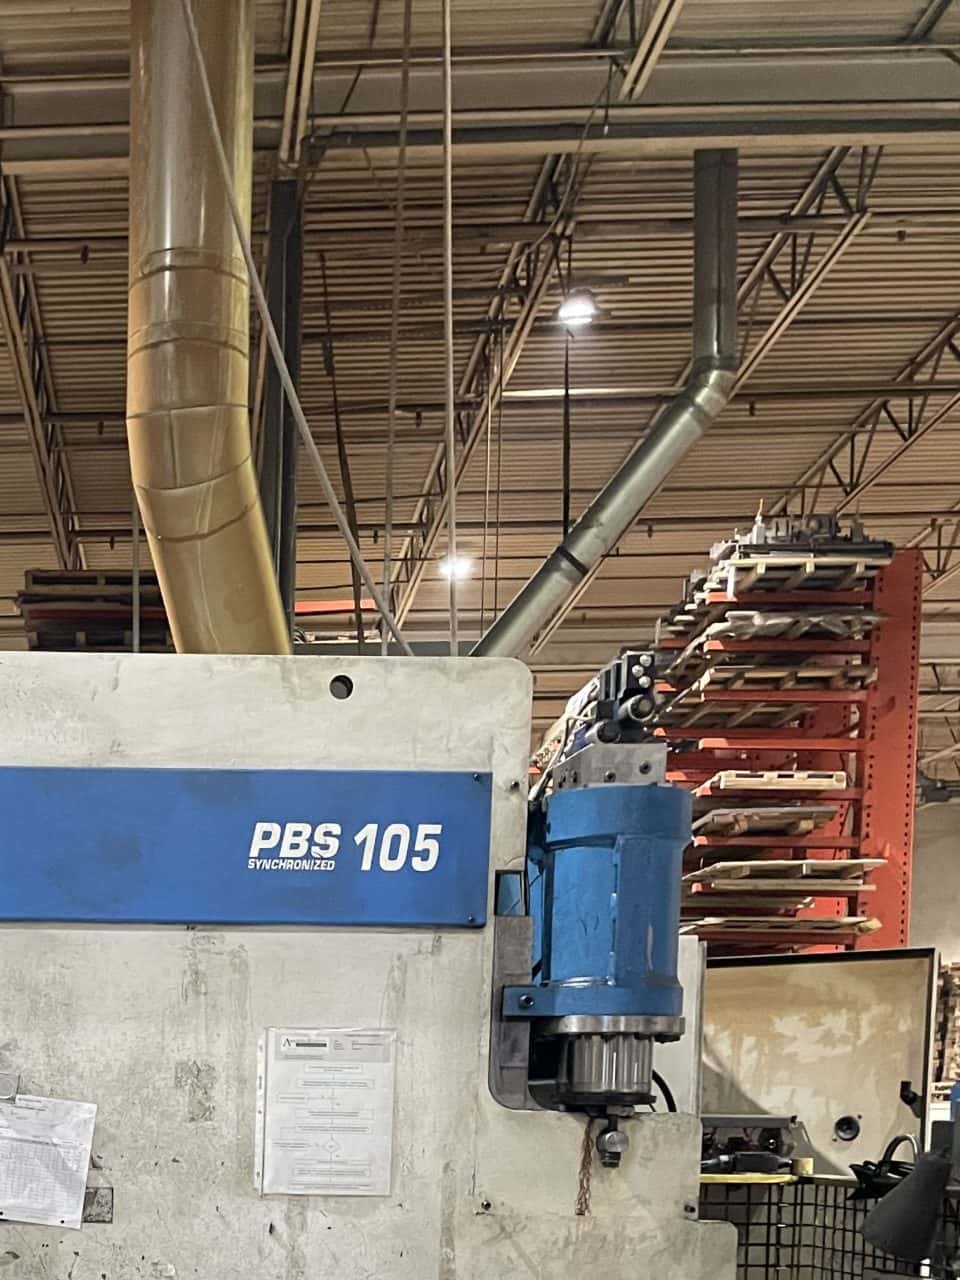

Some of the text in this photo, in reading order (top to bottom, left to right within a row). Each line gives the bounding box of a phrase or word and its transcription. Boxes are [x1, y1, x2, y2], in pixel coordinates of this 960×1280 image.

[249, 822, 443, 872] PBS 105
[248, 859, 335, 871] SYNCHRONIZED
